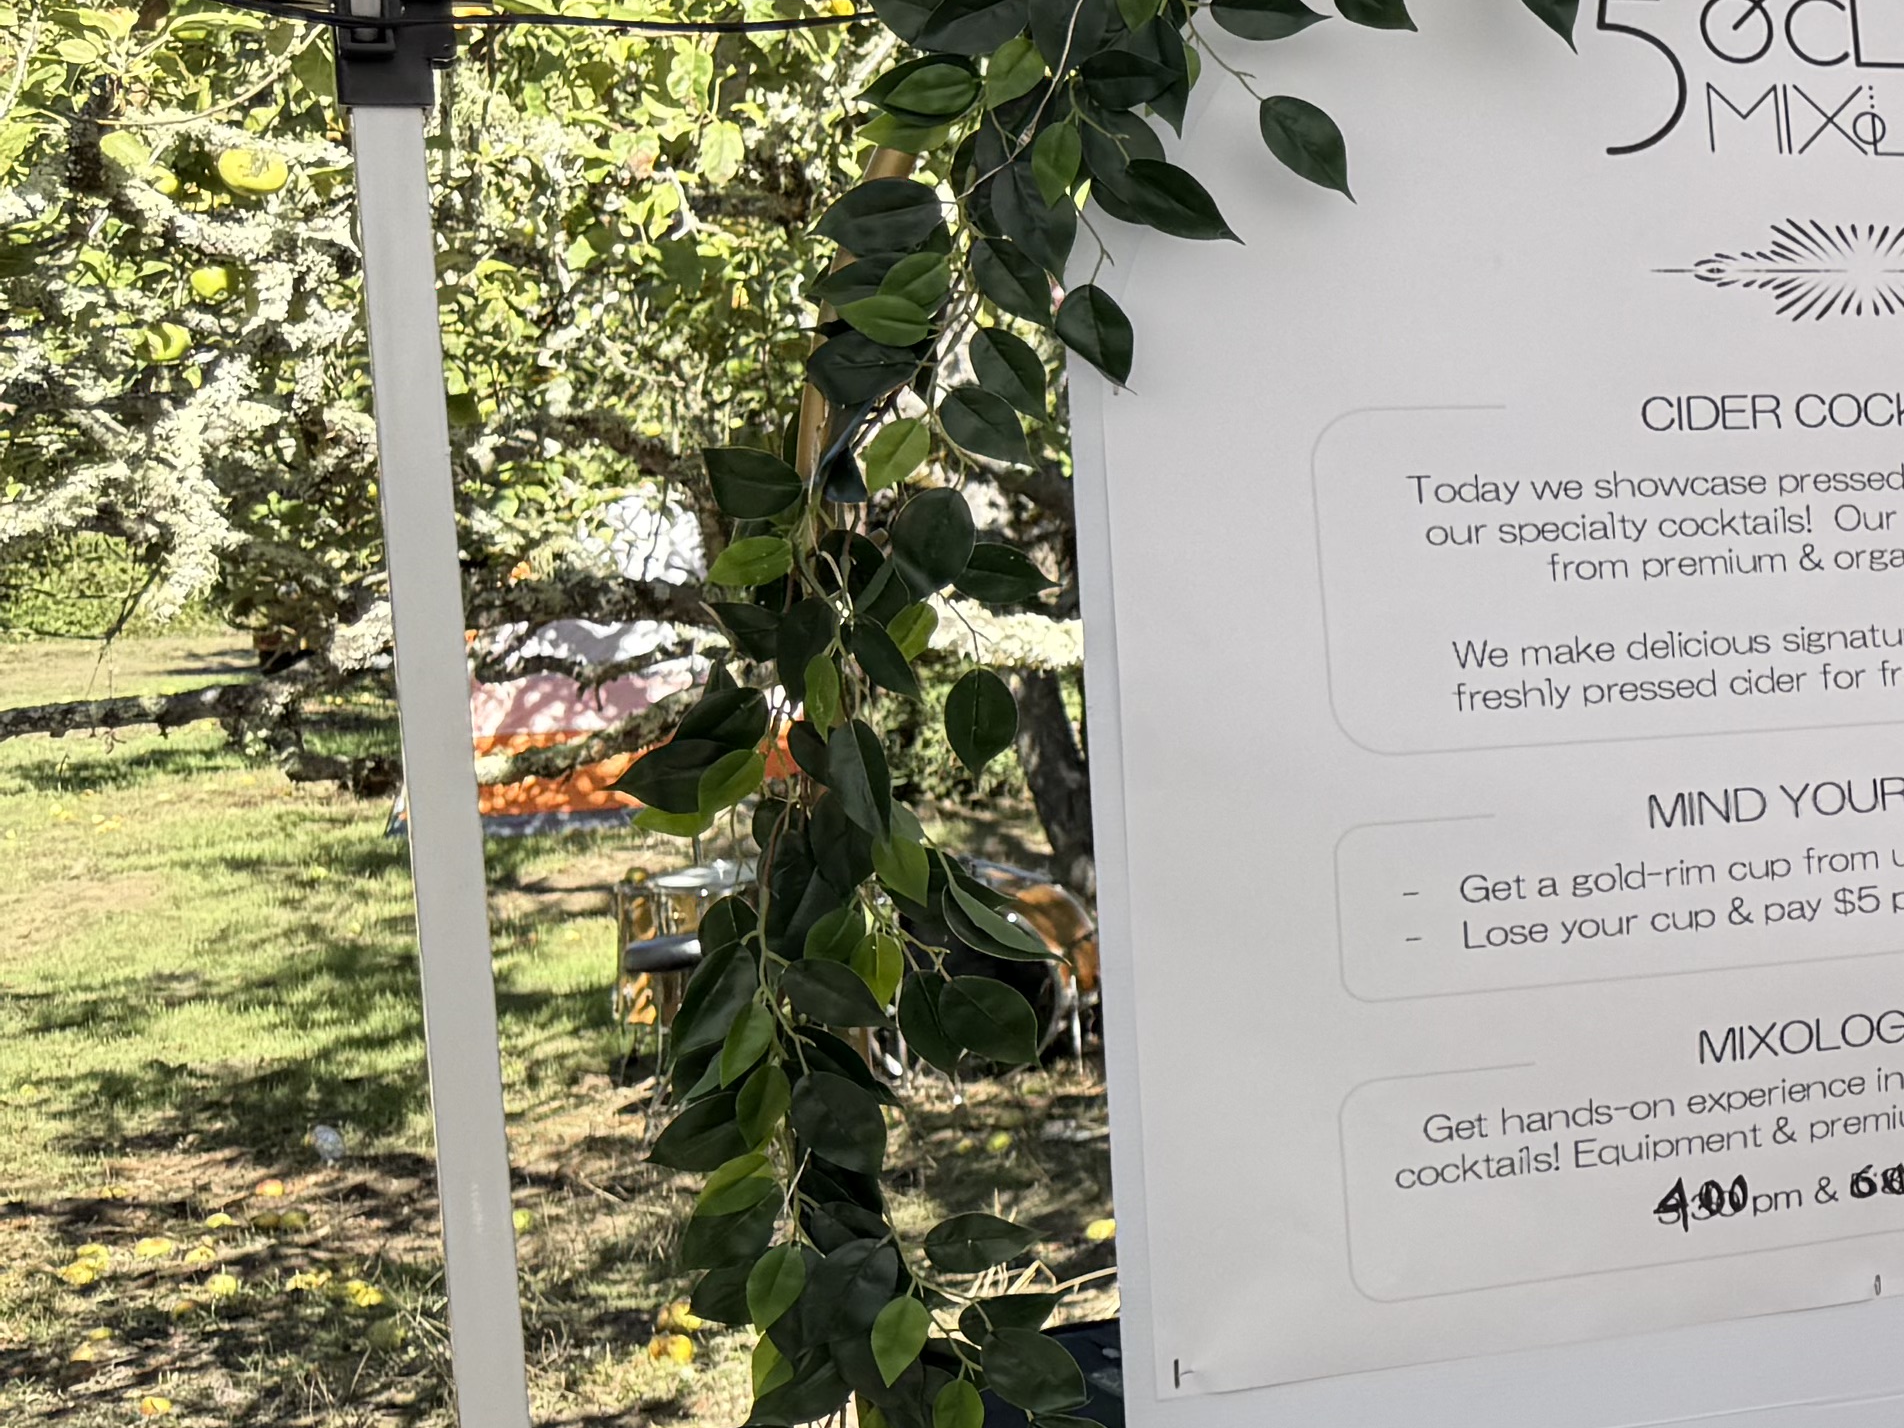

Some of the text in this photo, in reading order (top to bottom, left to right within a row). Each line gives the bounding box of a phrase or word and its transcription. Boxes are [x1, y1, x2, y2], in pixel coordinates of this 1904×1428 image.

[1641, 394, 1781, 431] CIDER
[1406, 474, 1521, 505] Today
[1529, 480, 1583, 500] we
[1594, 470, 1766, 499] showcase
[1779, 462, 1904, 497] pressed
[1426, 524, 1487, 546] our
[1498, 511, 1647, 546] specialty
[1658, 504, 1812, 538] cocktails!
[1834, 504, 1897, 532] Our
[1547, 553, 1628, 582] from
[1642, 548, 1786, 581] premium
[1799, 543, 1824, 571] &
[1452, 640, 1508, 669] We
[1521, 635, 1615, 666] make
[1627, 630, 1771, 660] delicious
[1452, 678, 1571, 712] freshly
[1583, 669, 1716, 707] pressed
[1729, 666, 1807, 695] cider
[1820, 663, 1866, 690] for
[1648, 787, 1767, 829] MIND
[1460, 874, 1526, 903] Get
[1538, 877, 1559, 897] a
[1572, 859, 1715, 898] gold-rim
[1728, 858, 1791, 881] cup
[1803, 847, 1879, 875] from
[1463, 920, 1548, 949] Lose
[1561, 915, 1638, 944] your
[1650, 909, 1715, 932] cup
[1728, 896, 1754, 925] &
[1765, 898, 1821, 926] pay
[1834, 885, 1880, 916] $5
[1423, 1114, 1488, 1143] Get
[1502, 1098, 1675, 1135] hands-on
[1687, 1076, 1865, 1114] experience
[1877, 1067, 1904, 1092] in
[1395, 1141, 1560, 1189] cocktails!
[1574, 1124, 1762, 1168] Equipment
[1772, 1116, 1797, 1145] &
[1814, 1176, 1839, 1204] &
